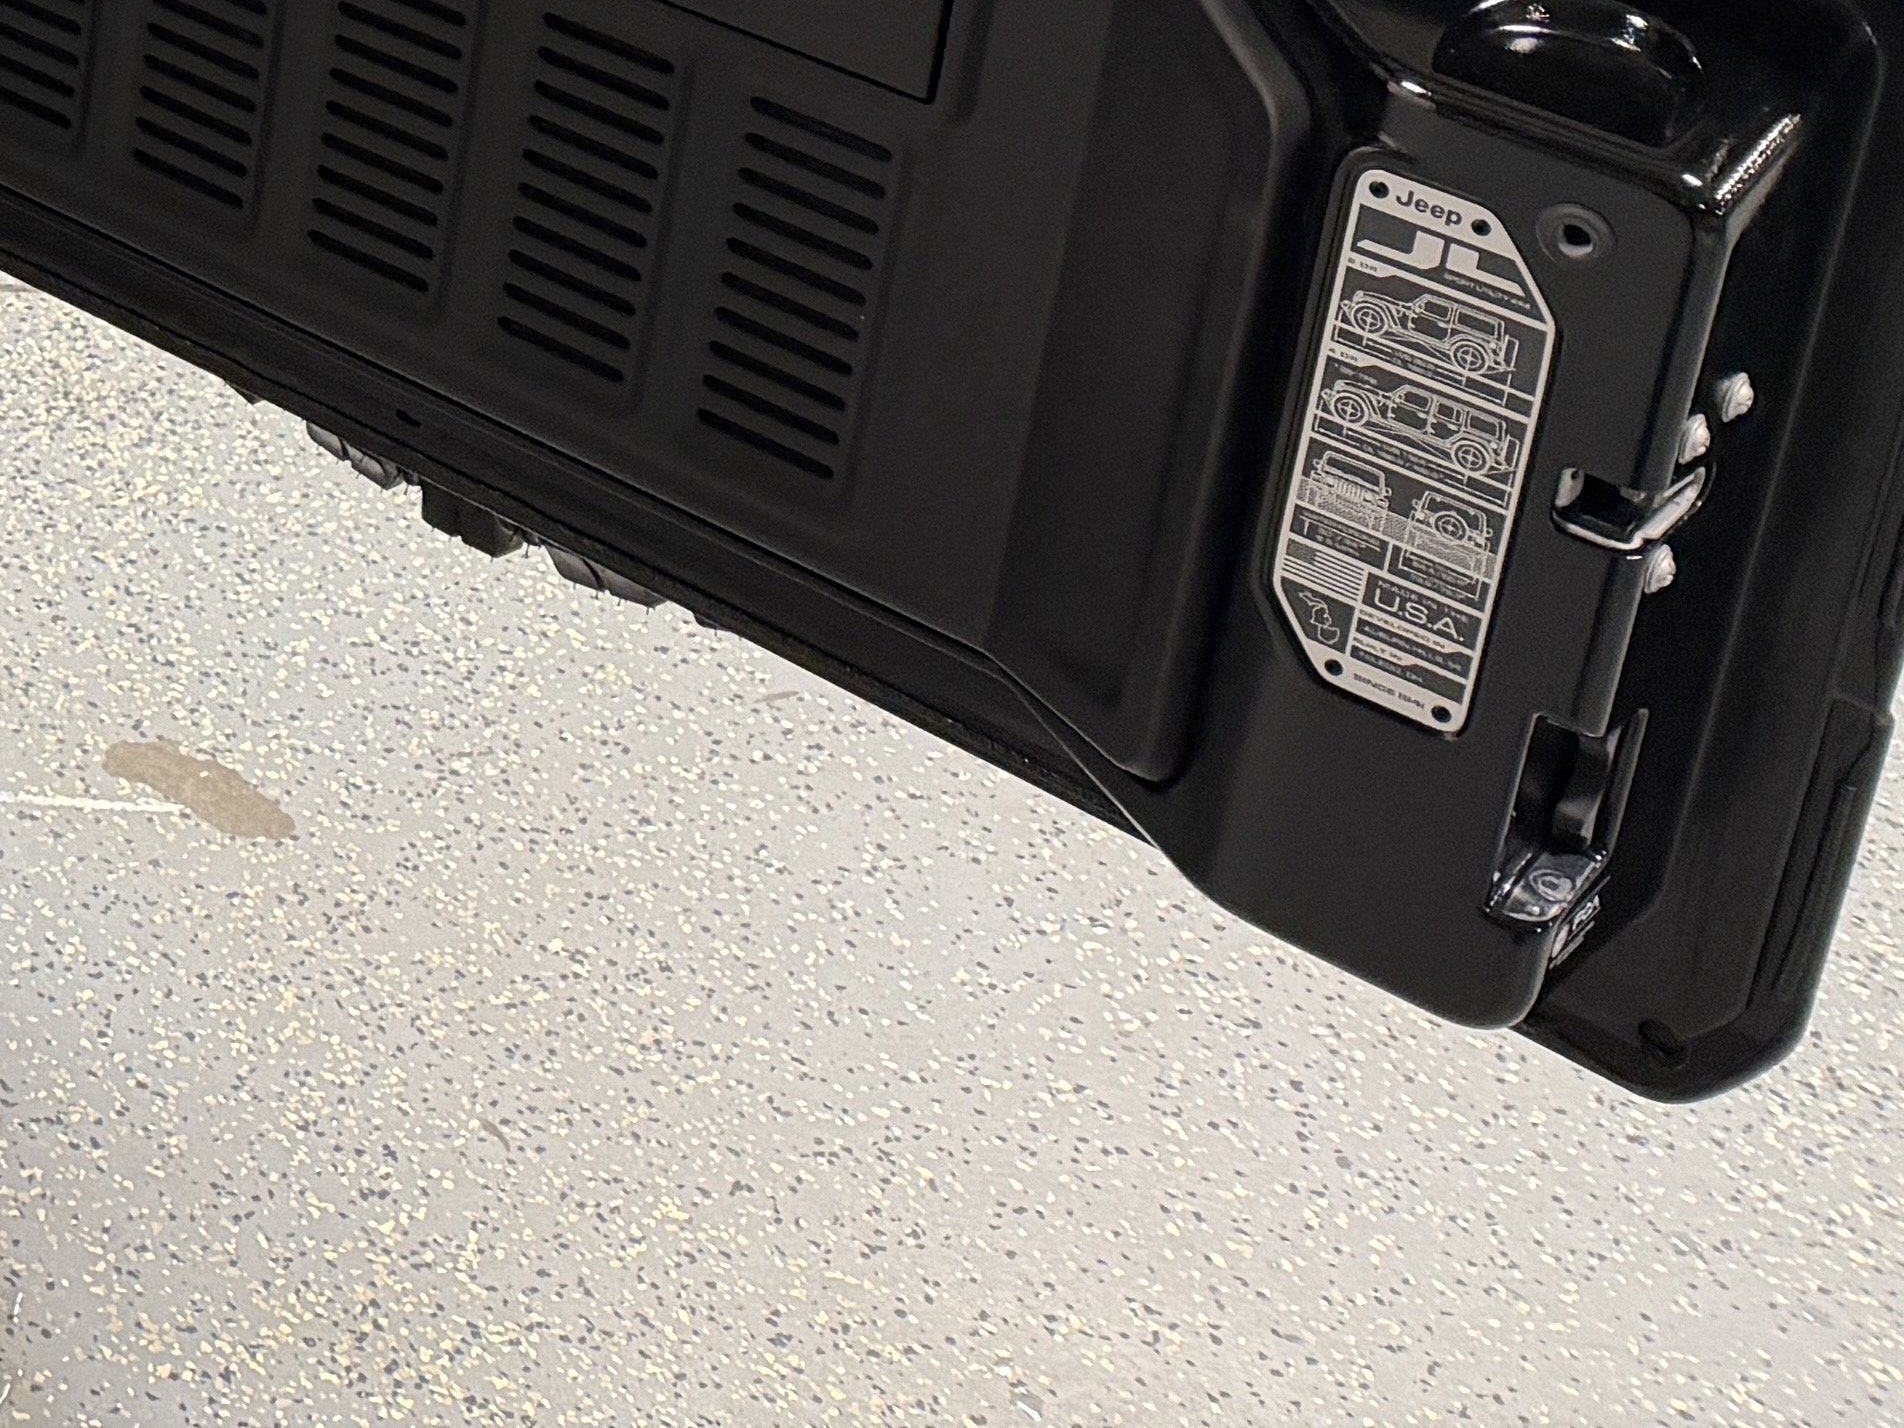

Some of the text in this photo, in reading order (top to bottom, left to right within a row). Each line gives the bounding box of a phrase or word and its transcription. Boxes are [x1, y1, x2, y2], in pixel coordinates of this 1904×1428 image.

[1395, 190, 1463, 226] Jeep
[1357, 230, 1525, 297] JL
[1374, 587, 1465, 642] U.S.A.
